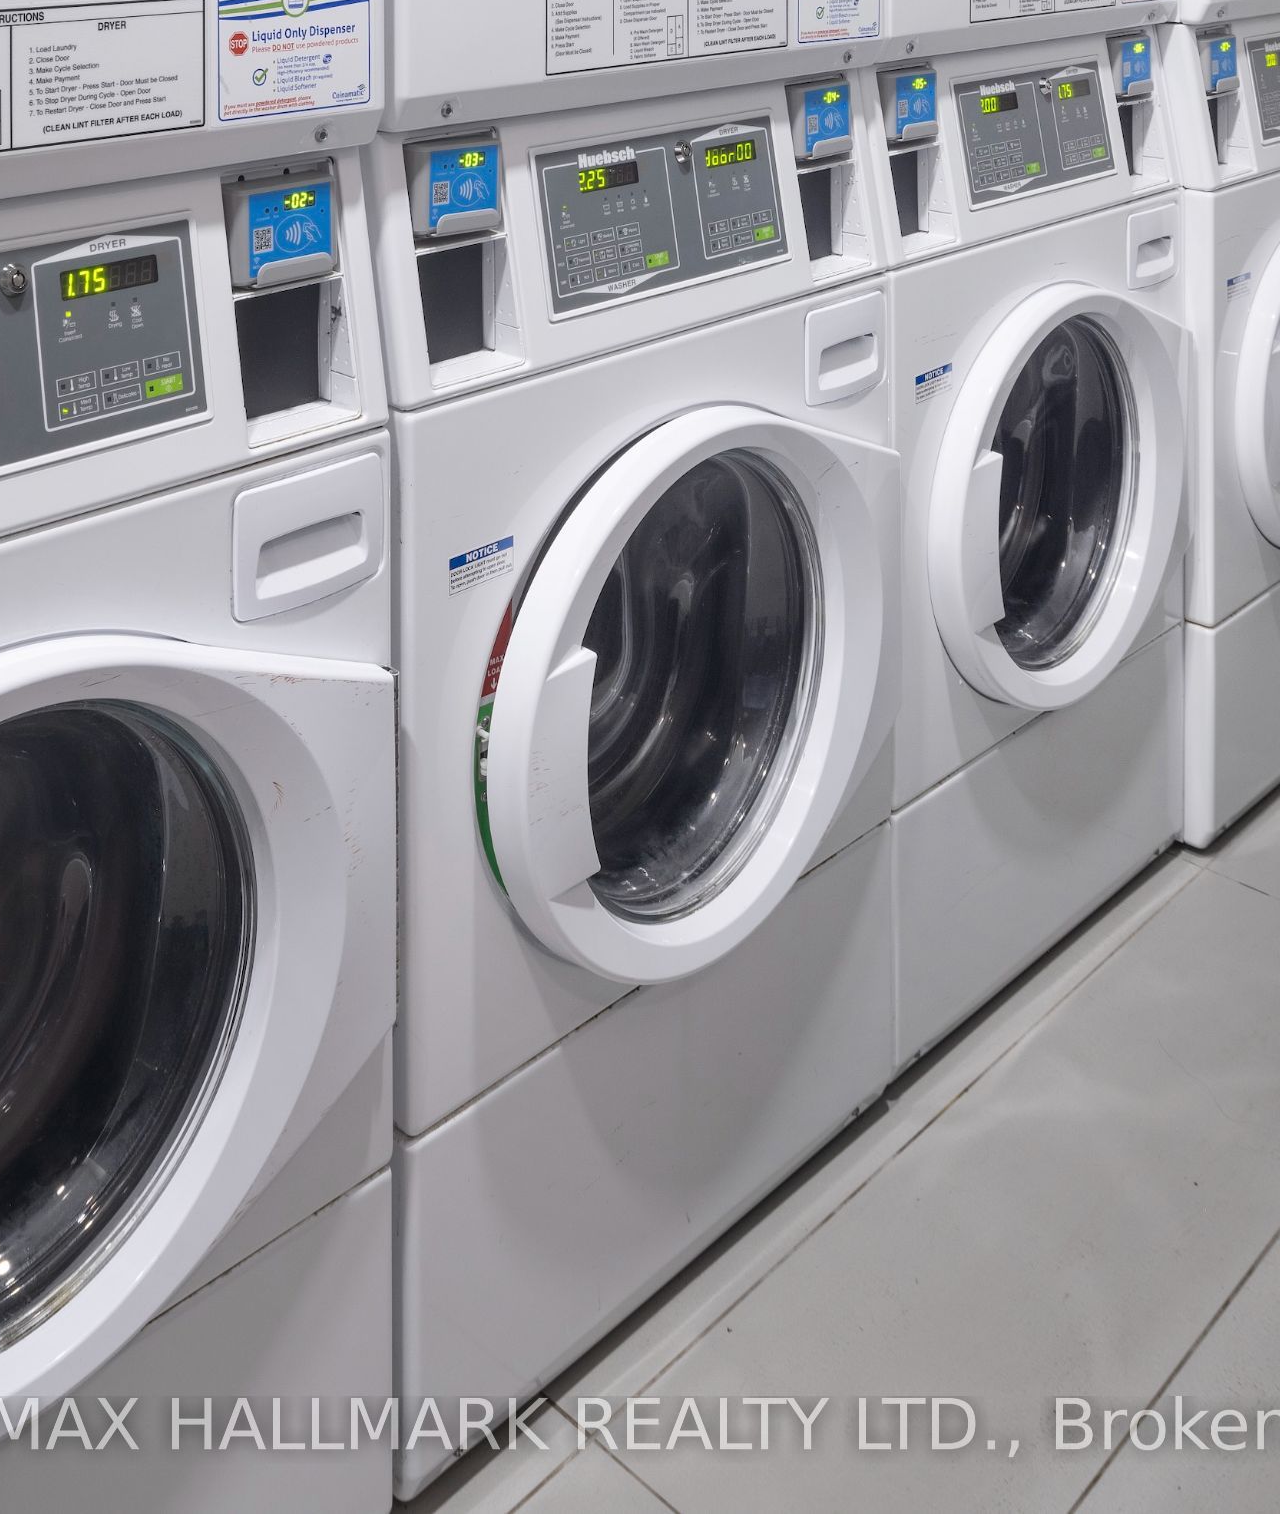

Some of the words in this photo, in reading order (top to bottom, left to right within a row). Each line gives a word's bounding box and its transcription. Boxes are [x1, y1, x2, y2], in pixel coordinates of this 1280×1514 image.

[97, 20, 126, 31] DRYER
[252, 29, 281, 44] Liquid
[284, 27, 306, 41] Only
[309, 22, 354, 38] Dispenser
[230, 38, 246, 48] STOP
[306, 39, 333, 48] powdered
[335, 37, 358, 46] products
[277, 56, 293, 64] Liquid
[294, 54, 320, 62] Detergent
[277, 76, 293, 84] Liquid
[277, 85, 293, 93] Liquid
[294, 82, 316, 90] Softener
[332, 88, 363, 99] Coinamatic
[980, 80, 1015, 95] Huebsch
[42, 122, 70, 133] (CLEAN
[72, 120, 88, 129] LINT
[90, 117, 113, 127] FILTER
[116, 114, 139, 124] AFTER
[141, 112, 159, 121] EACH
[161, 109, 182, 119] LOAD)
[718, 126, 738, 135] DRYER
[459, 152, 484, 167] -03-
[578, 146, 636, 169] Huebsch
[284, 192, 314, 209] -02-
[89, 237, 126, 253] DRYER
[65, 267, 105, 297] 1.75
[608, 279, 636, 292] WASHER
[924, 367, 943, 381] NOTICE
[466, 542, 499, 563] NOTICE
[490, 654, 504, 666] MAX
[488, 666, 501, 677] LOA
